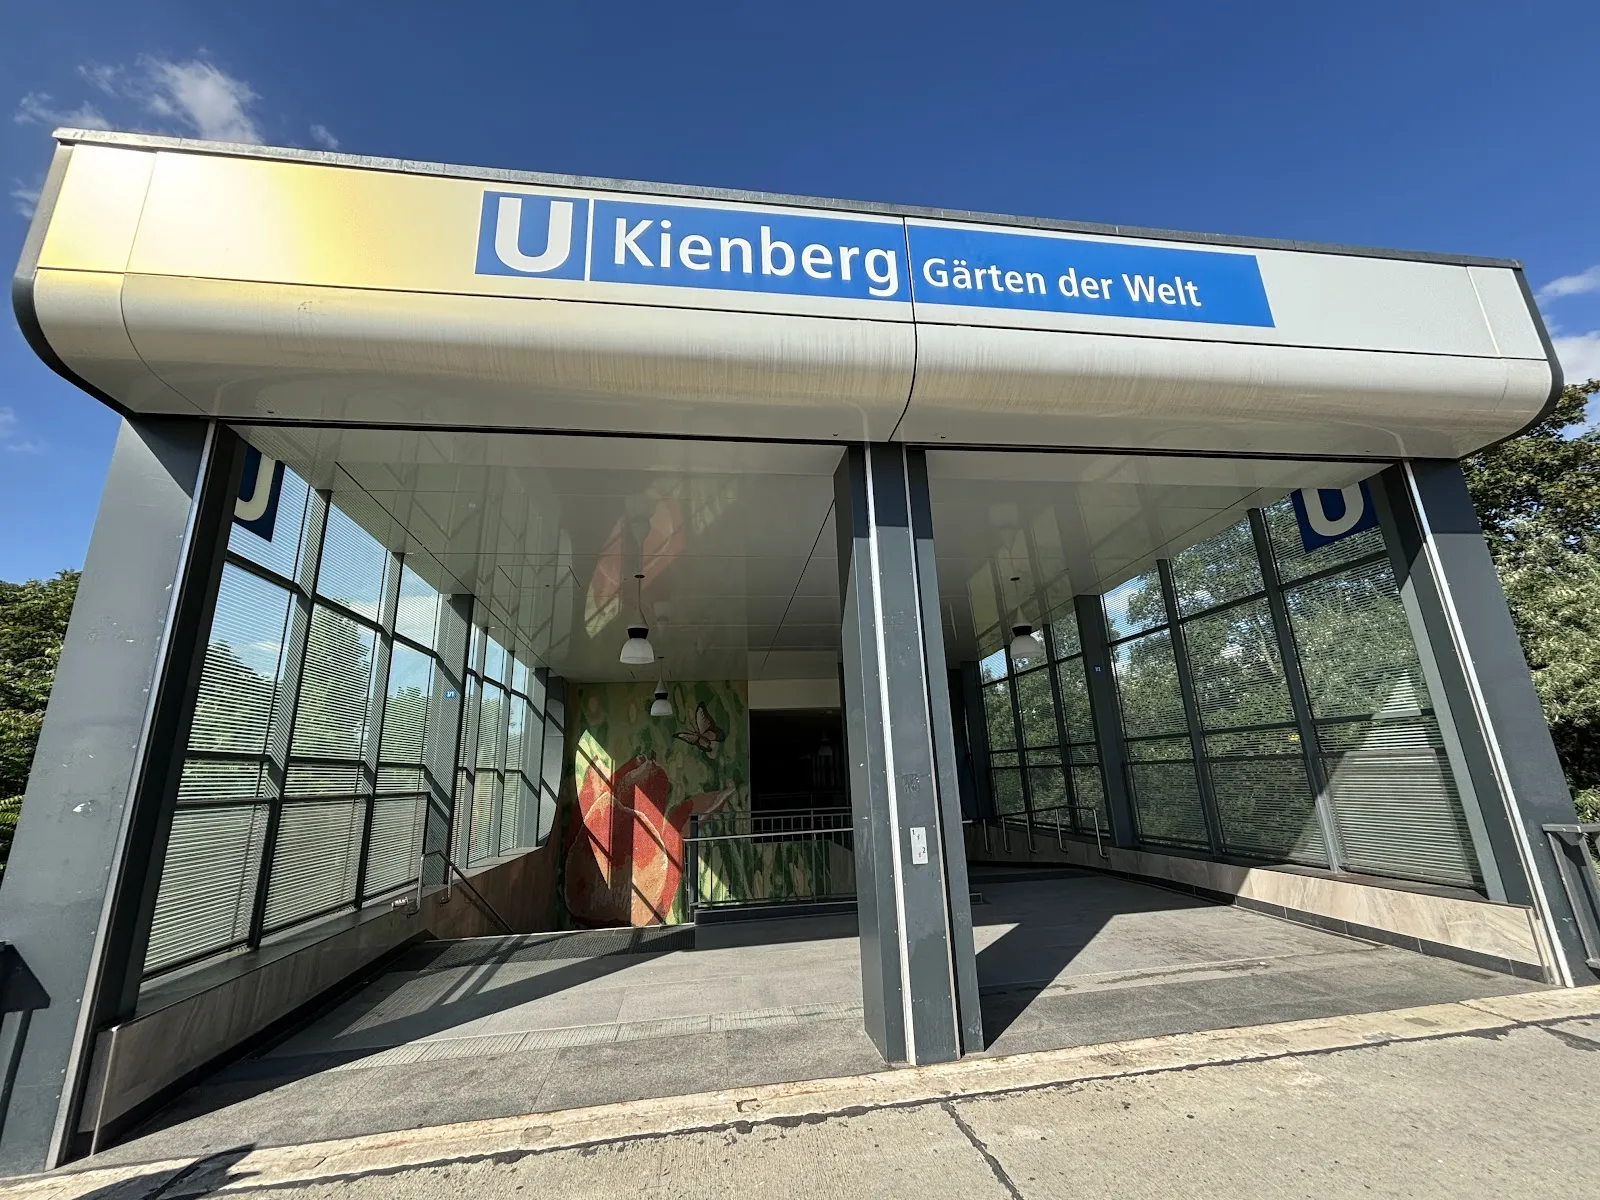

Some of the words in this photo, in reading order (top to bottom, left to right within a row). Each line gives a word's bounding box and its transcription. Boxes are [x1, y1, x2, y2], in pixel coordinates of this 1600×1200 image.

[494, 197, 574, 273] U
[614, 217, 899, 298] Kienberg
[922, 257, 1047, 295] Gärten
[1058, 267, 1113, 300] der
[1121, 273, 1202, 307] Welt
[1300, 482, 1364, 537] U
